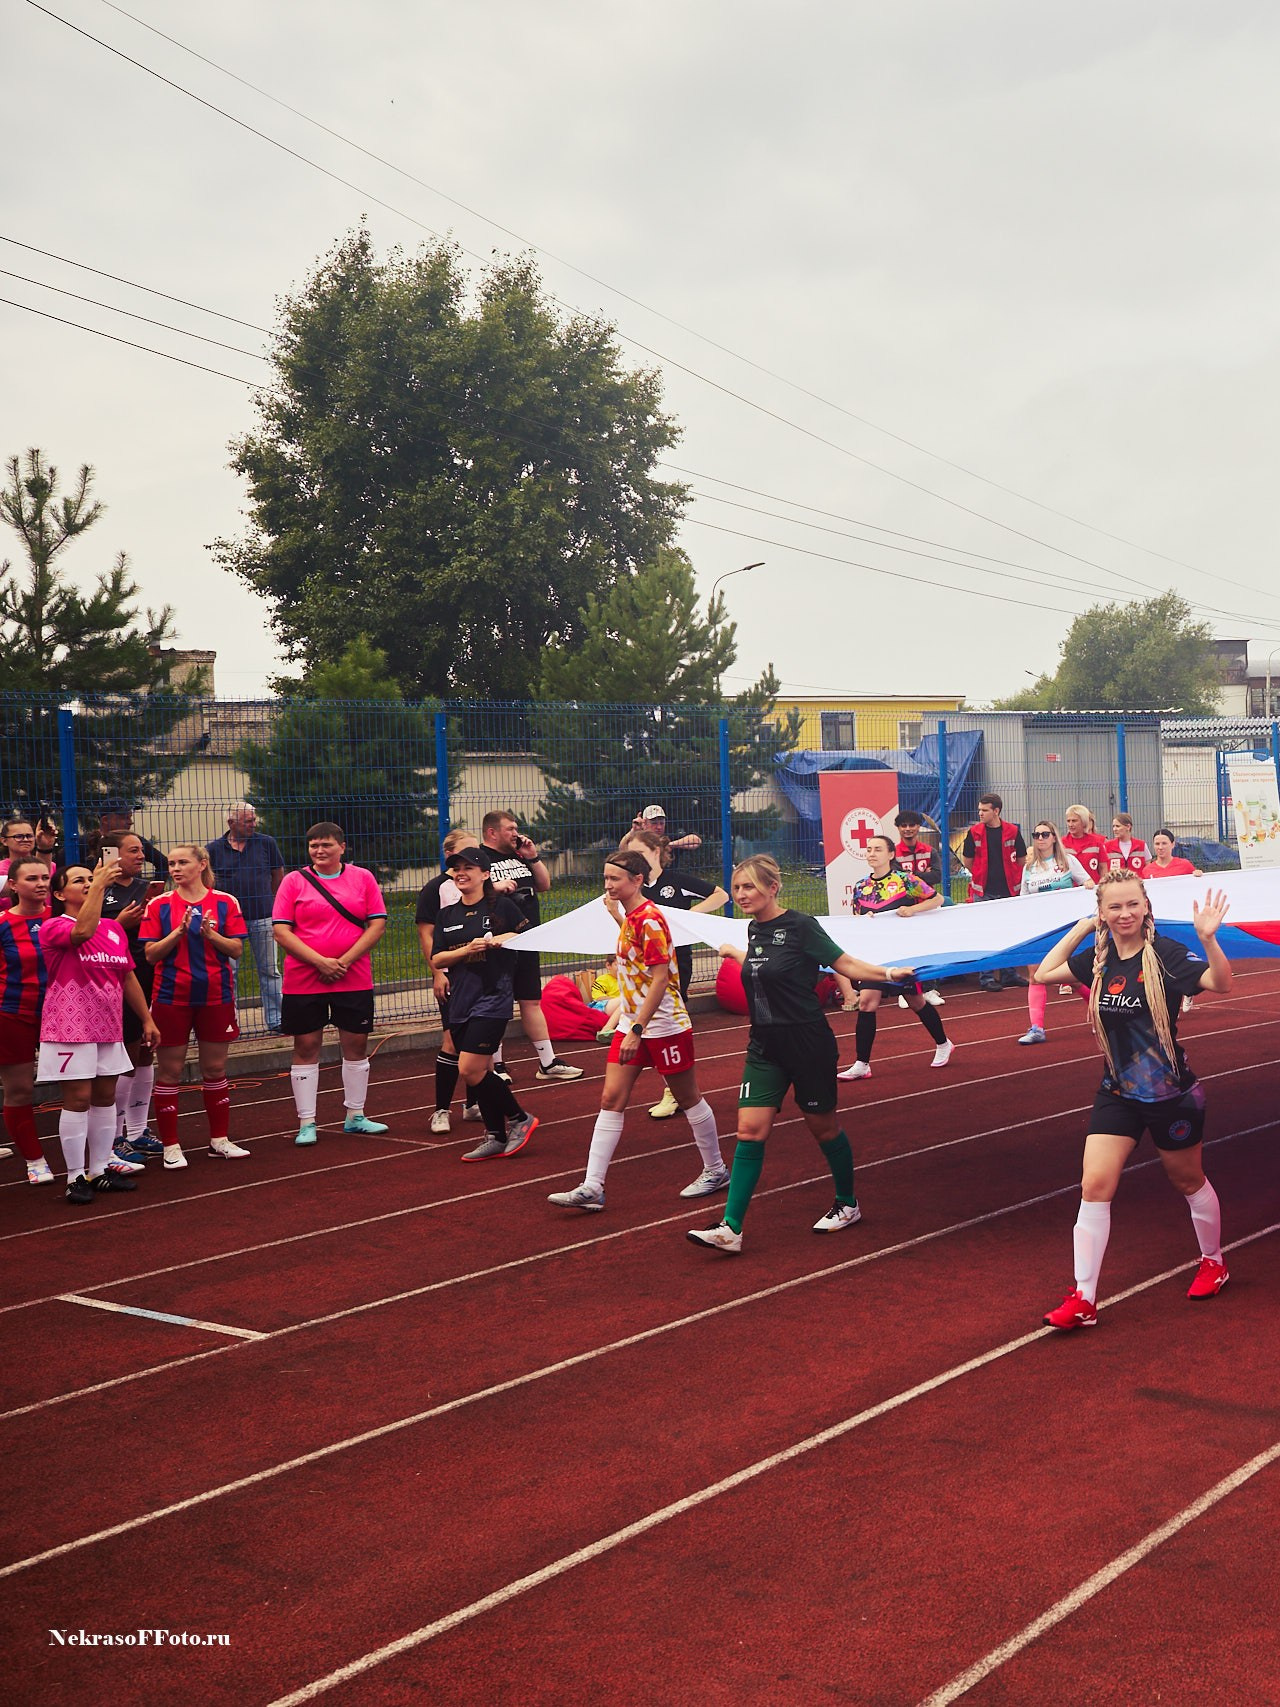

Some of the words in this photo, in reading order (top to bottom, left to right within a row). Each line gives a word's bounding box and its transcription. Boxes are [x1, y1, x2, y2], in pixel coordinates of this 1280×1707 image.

[845, 811, 880, 826] РОССИЙСКИЙ
[489, 867, 533, 883] BUSINESS
[57, 1052, 74, 1073] 7
[661, 1045, 681, 1066] 15
